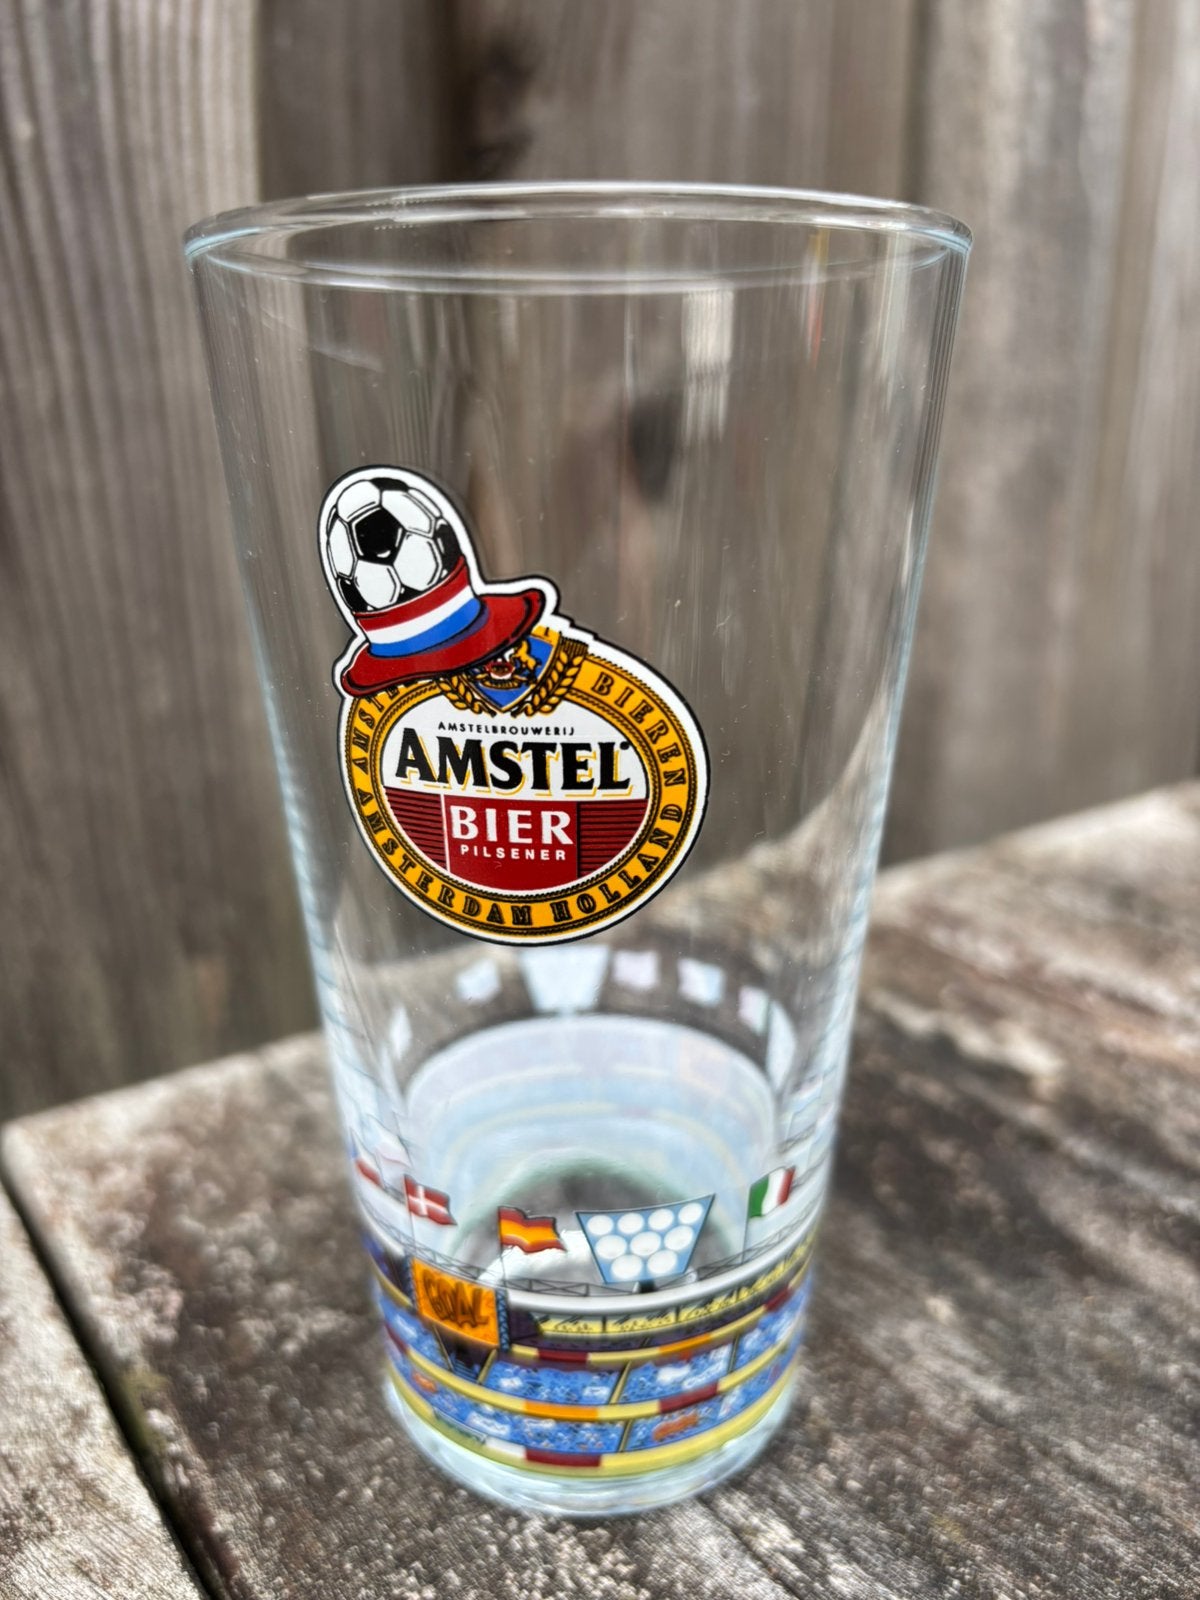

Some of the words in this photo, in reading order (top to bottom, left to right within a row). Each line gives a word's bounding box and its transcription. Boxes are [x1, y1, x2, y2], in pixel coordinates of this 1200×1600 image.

[352, 681, 418, 775] AMST
[591, 671, 687, 788] BIEREN
[438, 721, 575, 736] AMSTELBROUWERIJ
[395, 727, 632, 793] AMSTEL
[450, 805, 574, 845] BIER
[353, 787, 533, 926] AMSTERDAM
[551, 804, 684, 923] HOLLAND
[460, 844, 566, 861] PILSENER
